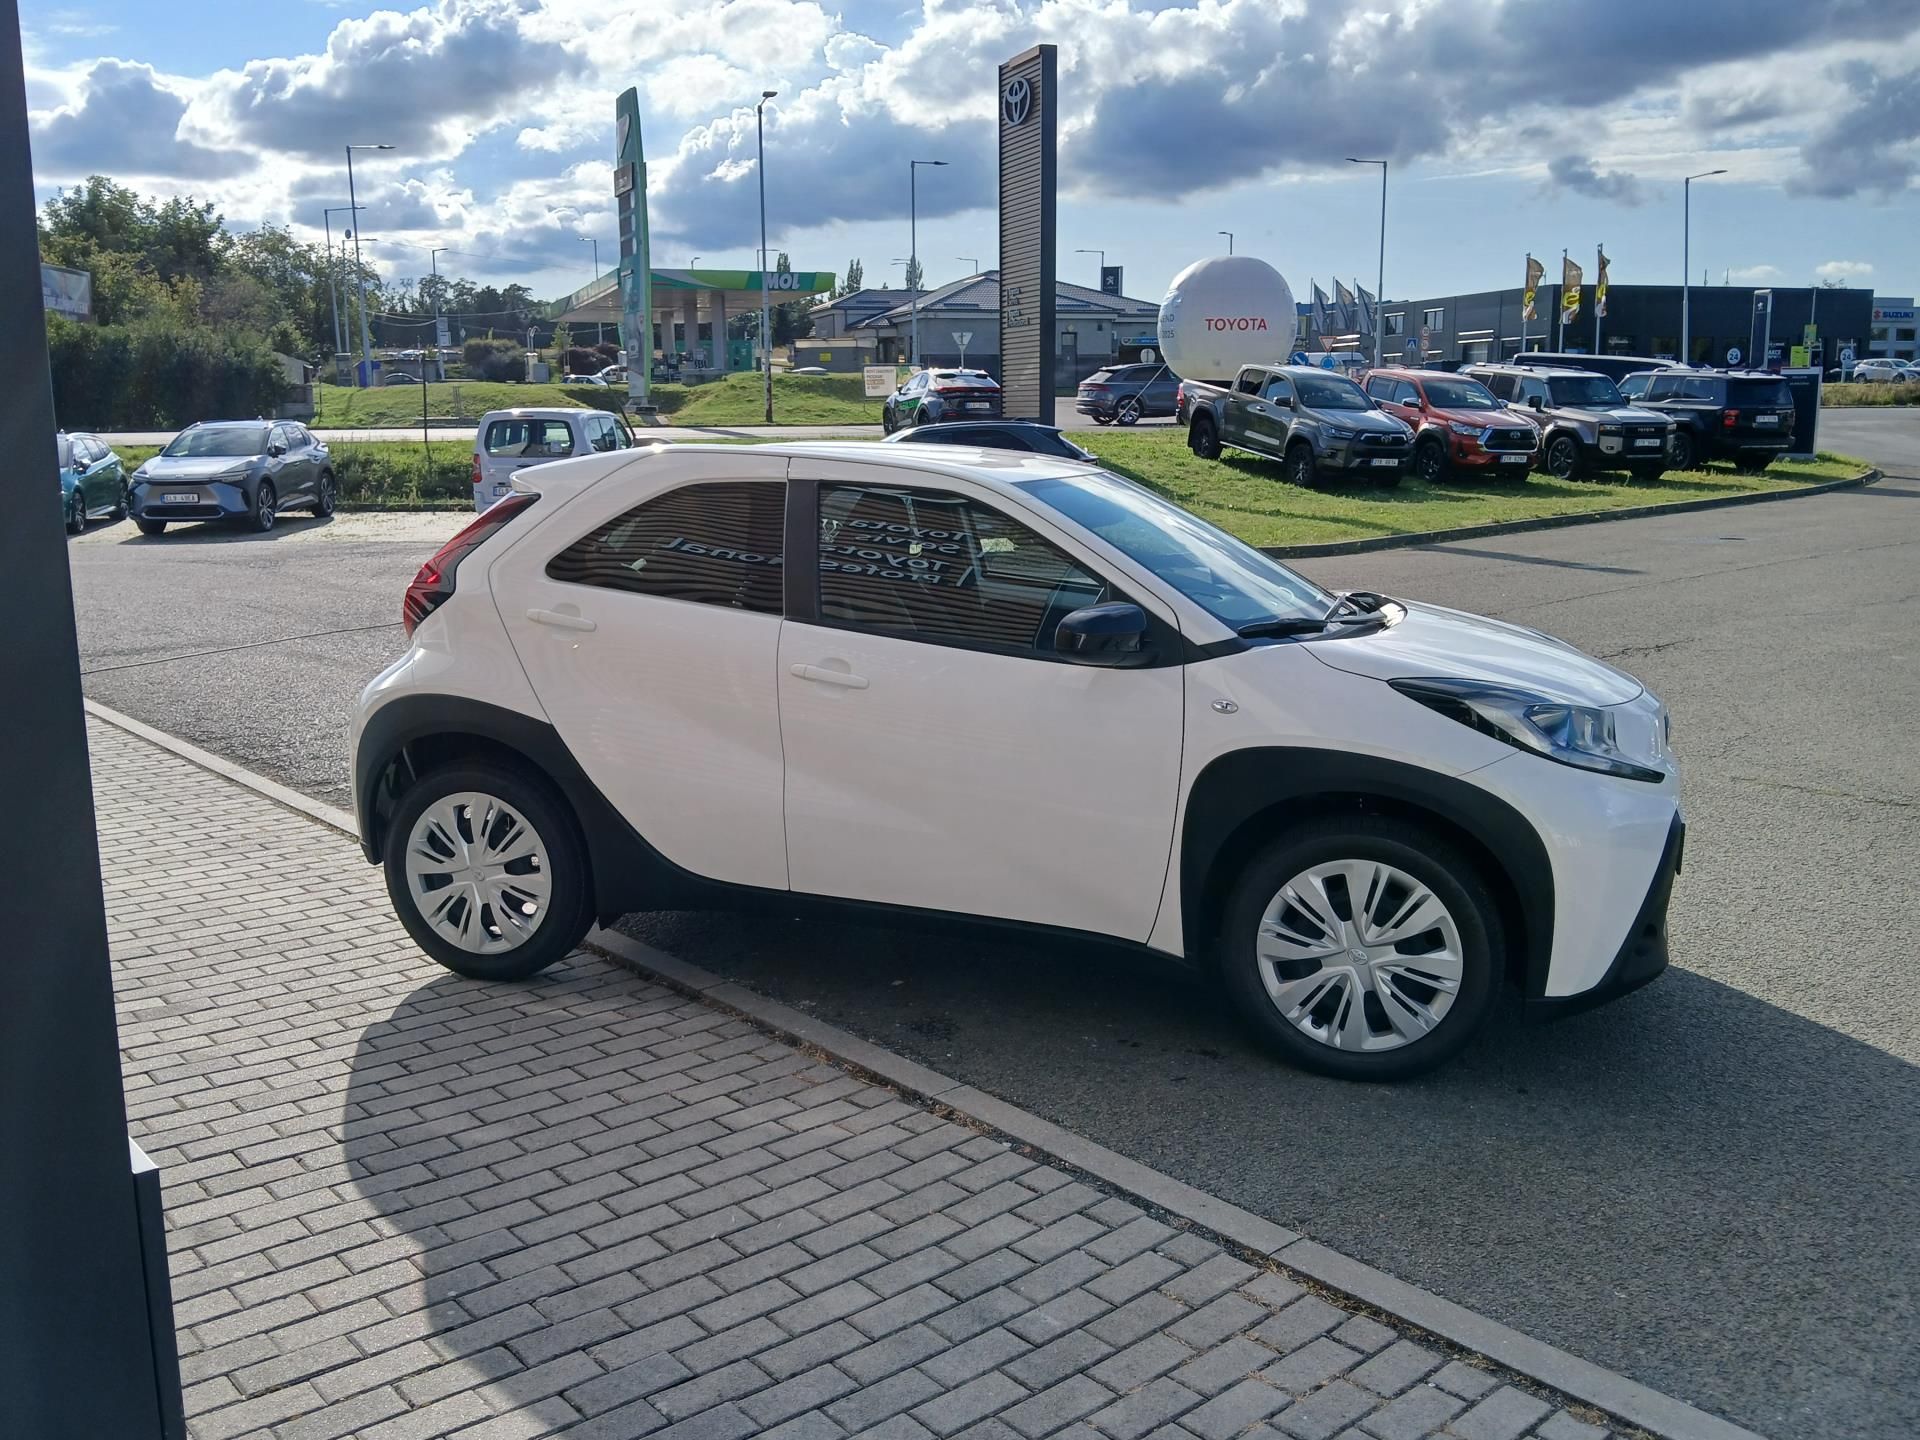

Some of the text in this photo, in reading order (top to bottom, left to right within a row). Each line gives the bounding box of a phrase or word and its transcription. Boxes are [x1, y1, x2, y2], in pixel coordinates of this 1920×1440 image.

[766, 273, 800, 290] MOL
[1882, 311, 1914, 319] SUZUKI
[1205, 318, 1268, 331] TOYOTA
